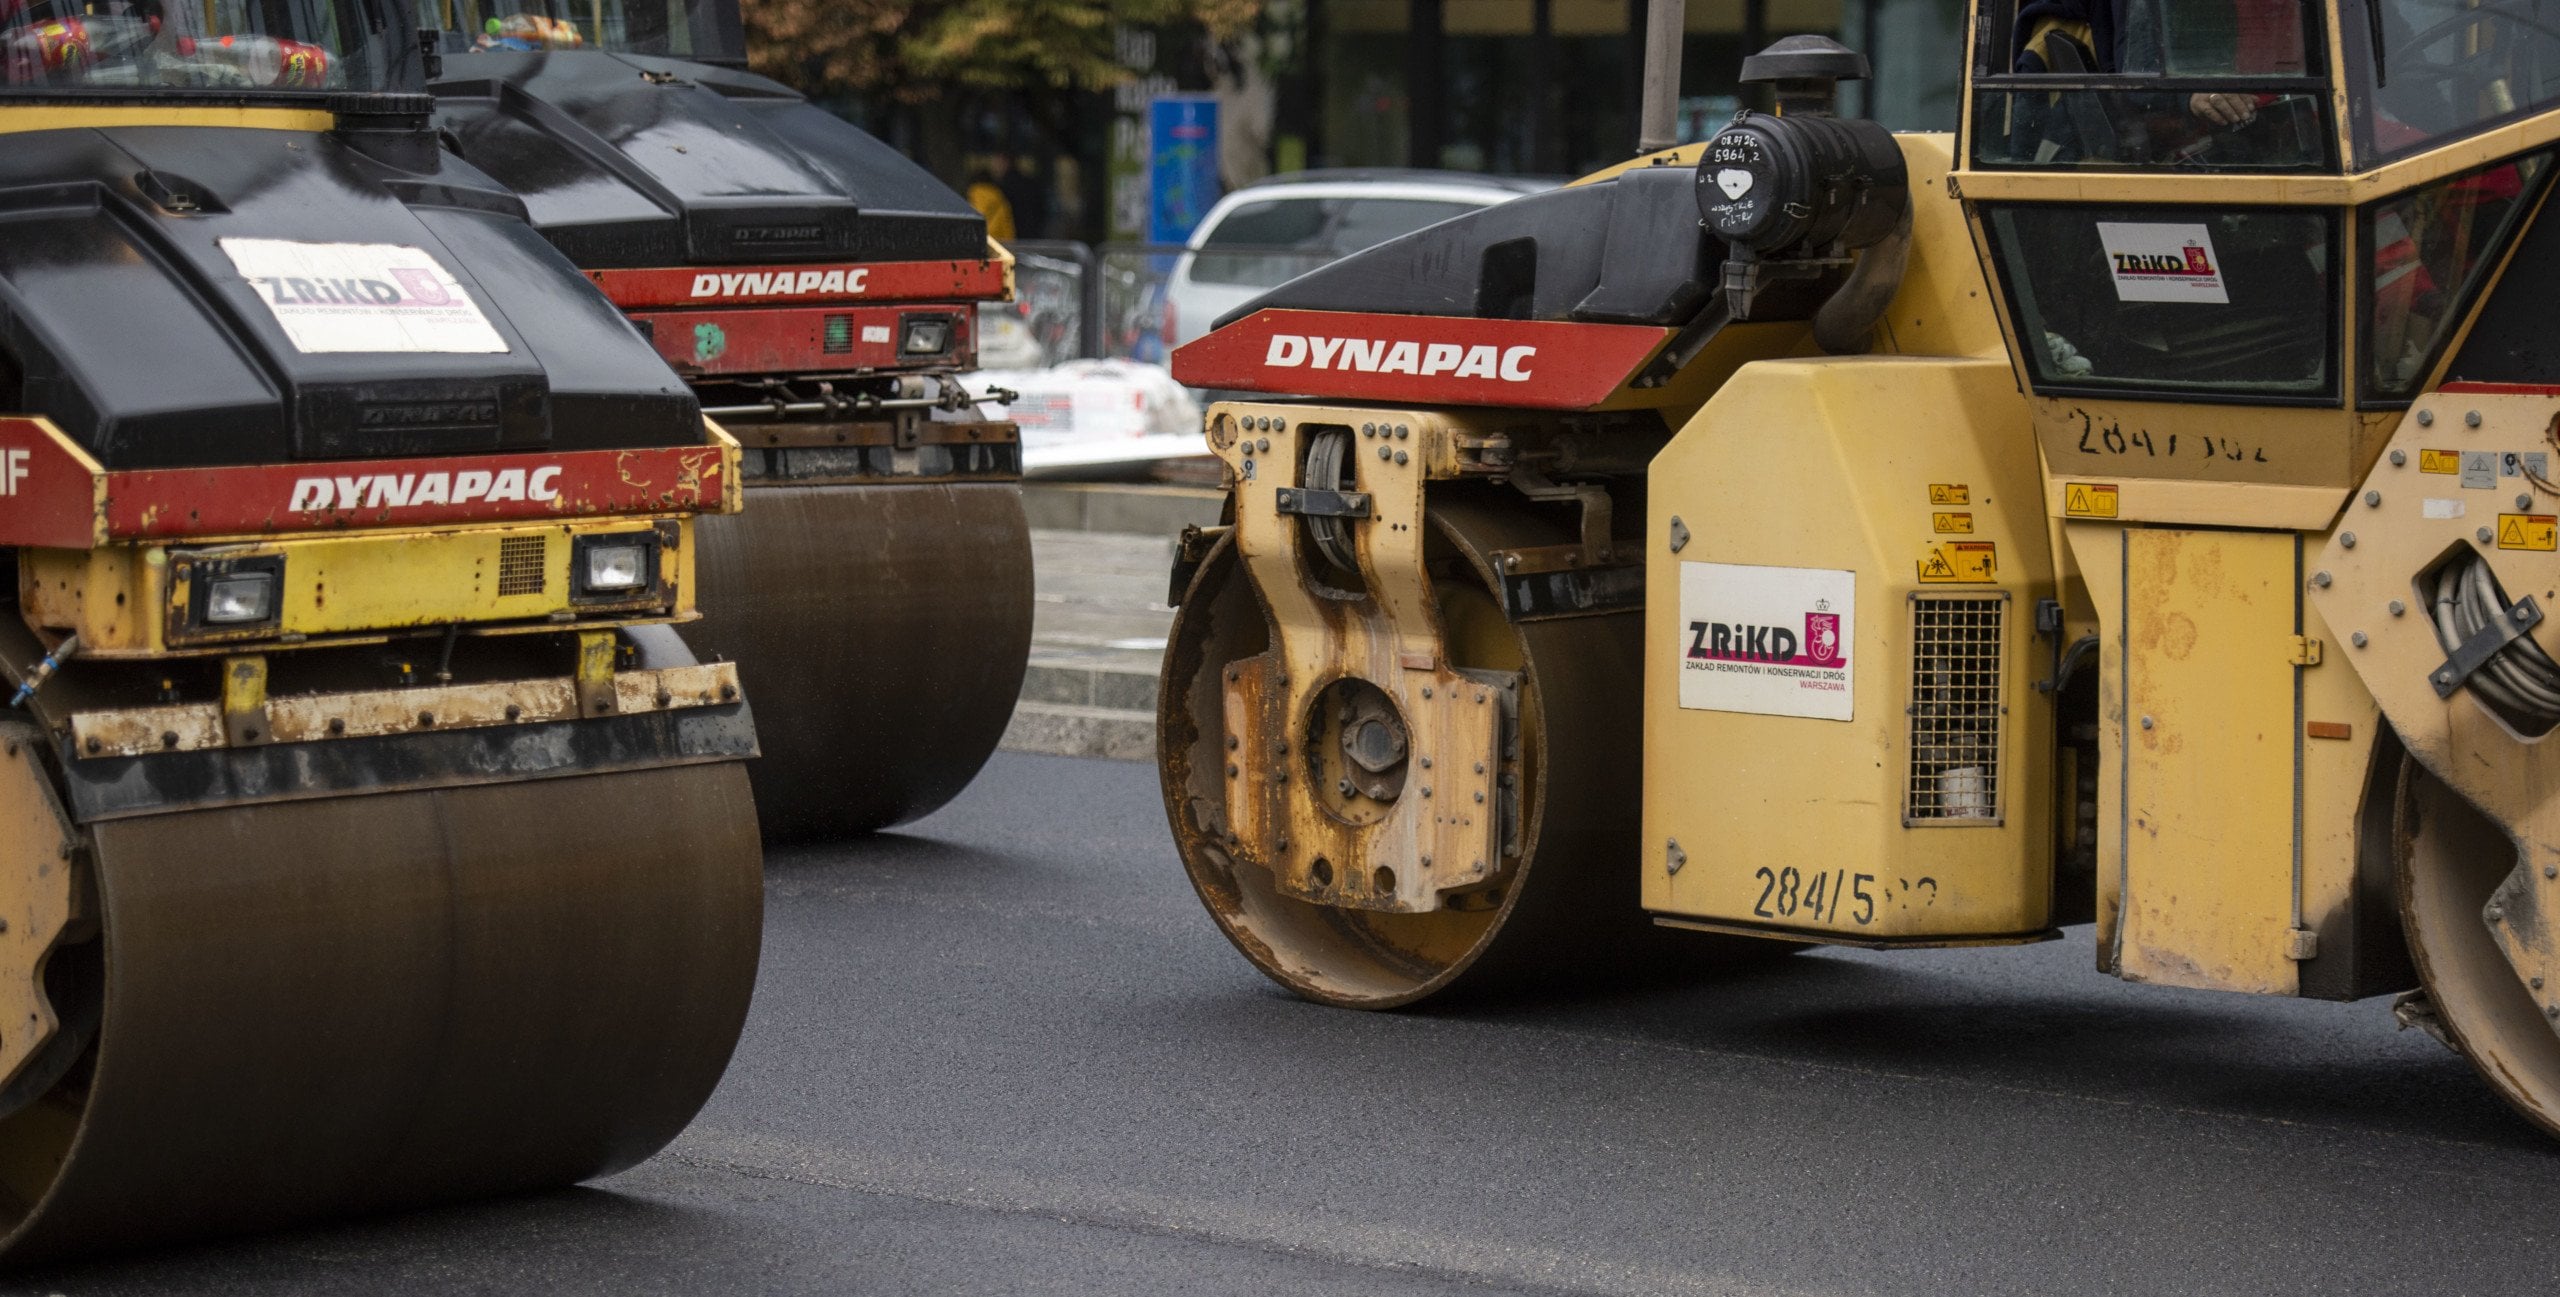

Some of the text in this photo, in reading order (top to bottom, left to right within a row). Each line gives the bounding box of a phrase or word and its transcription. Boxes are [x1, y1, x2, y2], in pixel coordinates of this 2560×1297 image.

[690, 268, 870, 298] DYNAPAC
[1264, 334, 1537, 382] DYNAPAC
[288, 466, 563, 513] DYNAPAC
[1689, 621, 1798, 662] ZRiKD
[1686, 661, 1715, 672] ZAKŁAD
[1716, 663, 1762, 675] REMONTÓW
[1767, 667, 1821, 679] KONSERWACJI
[1822, 669, 1846, 681] DRÓG
[1799, 681, 1846, 692] WARSZAWA
